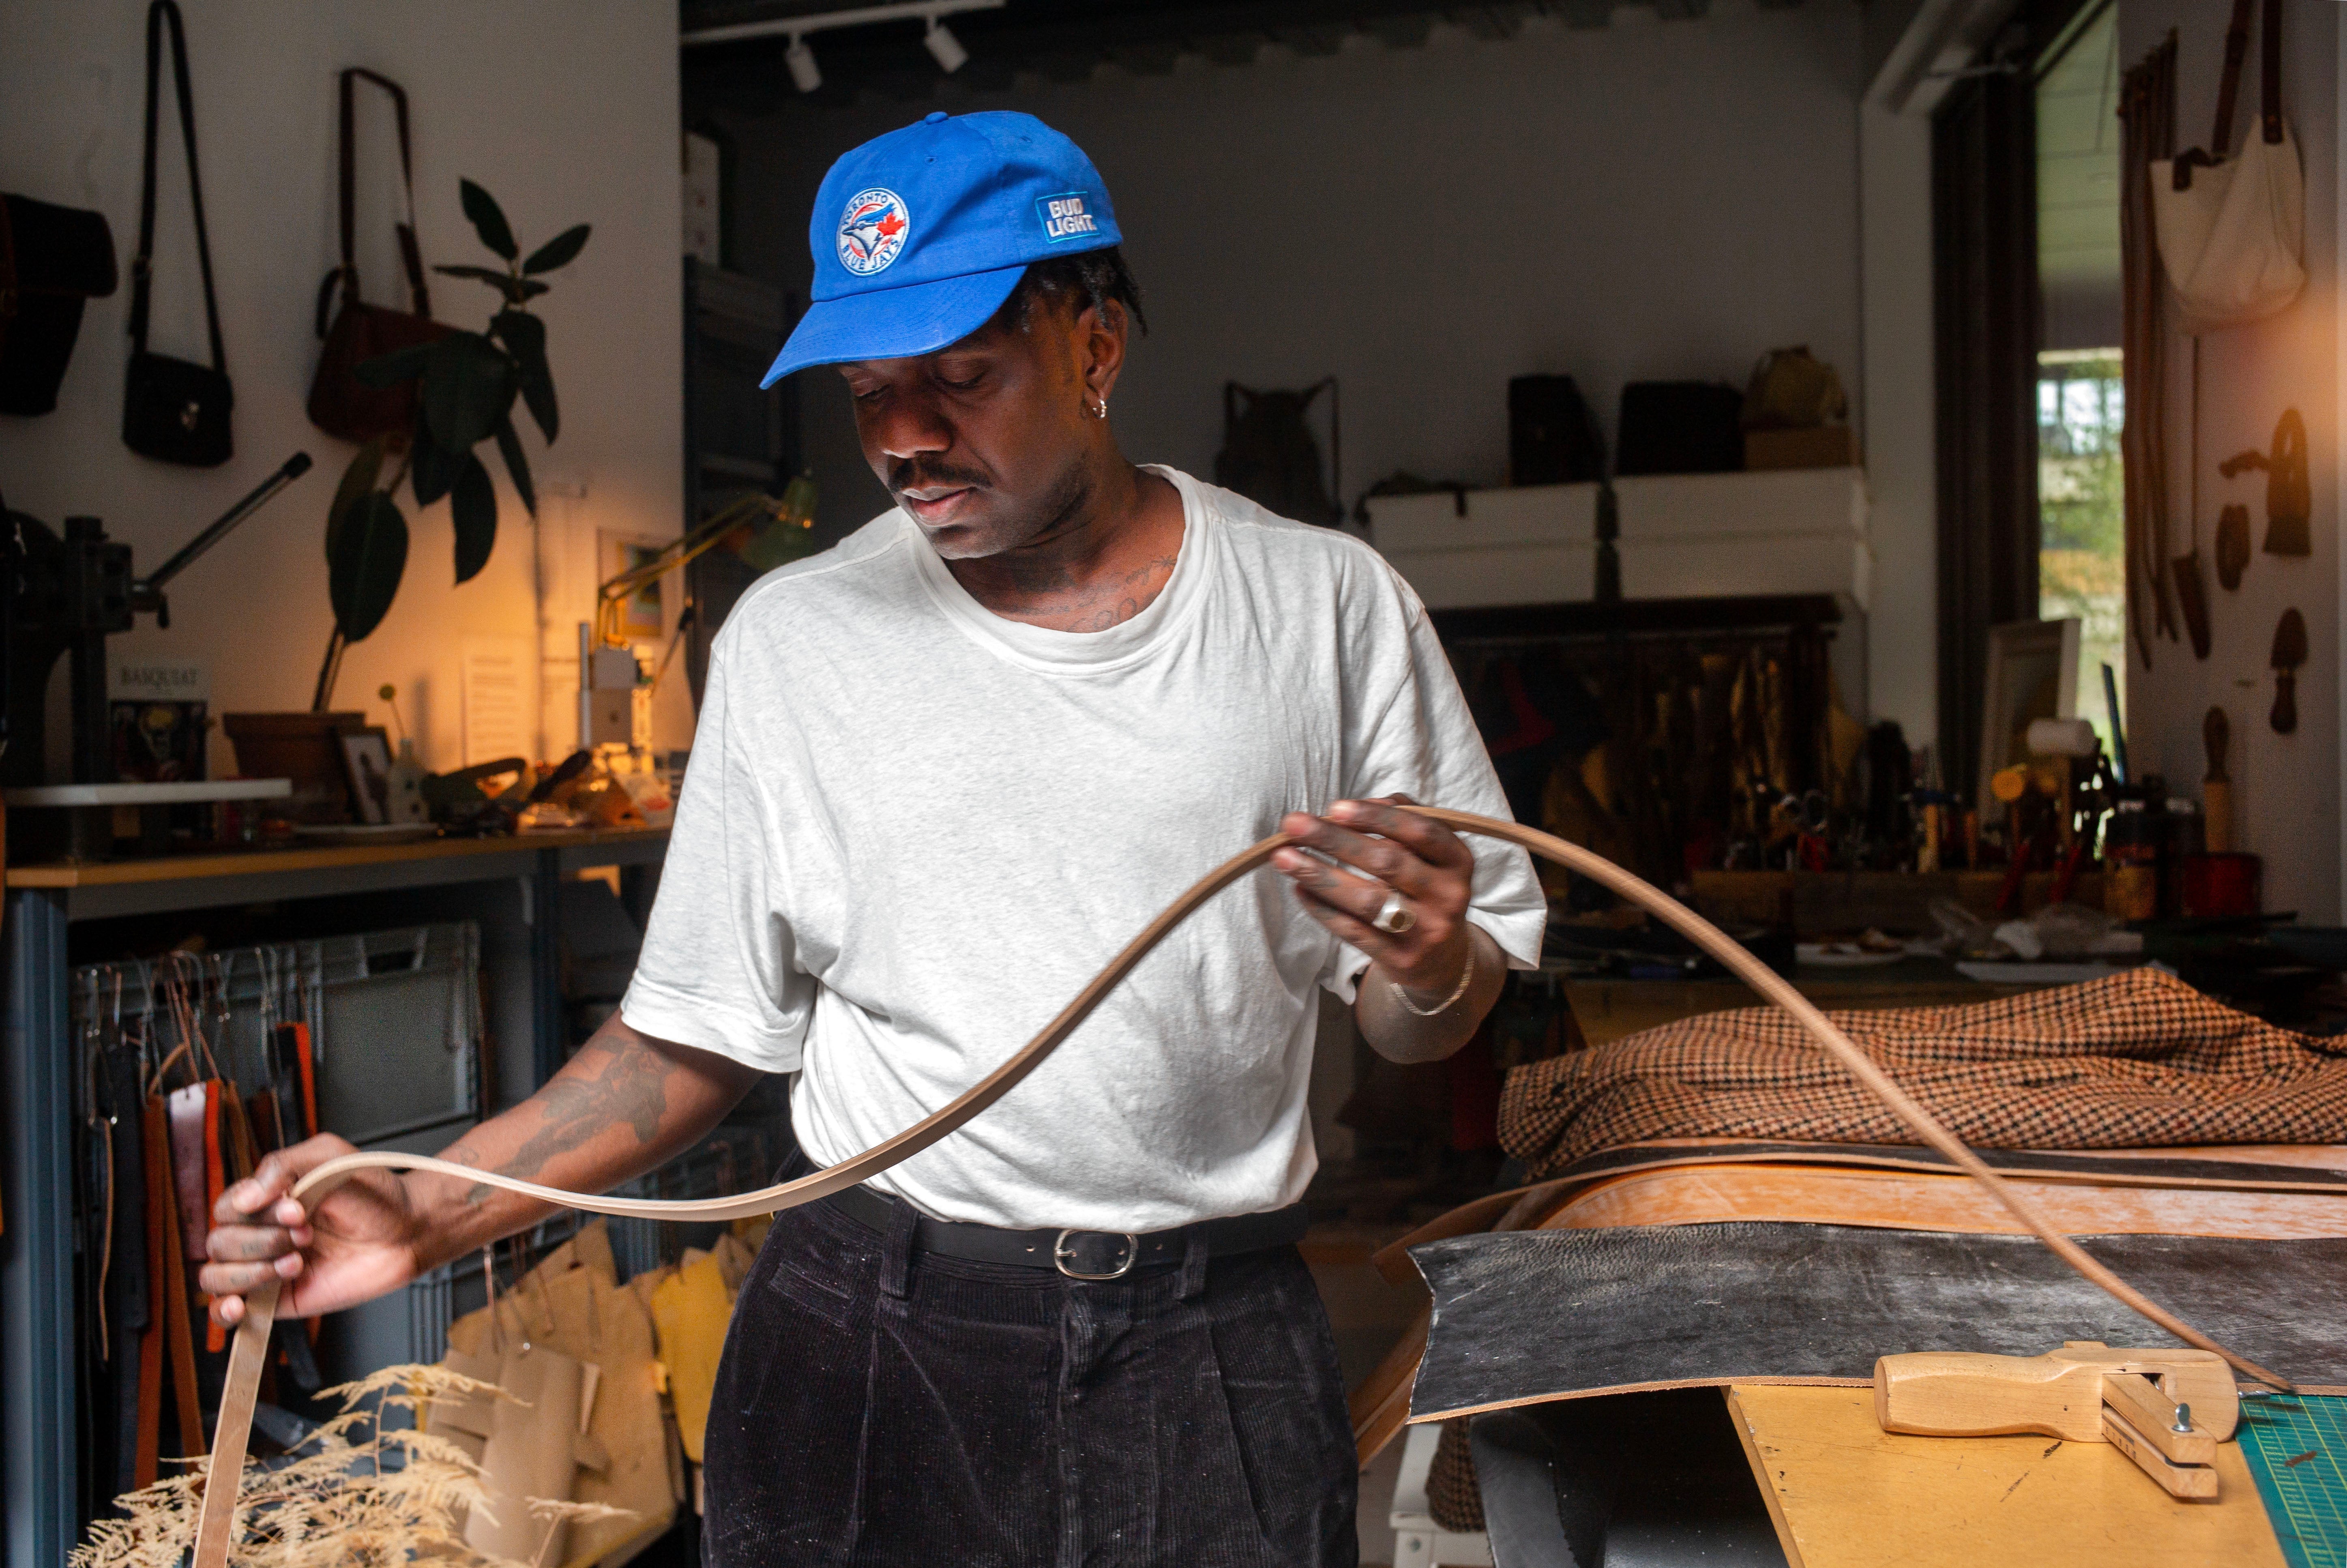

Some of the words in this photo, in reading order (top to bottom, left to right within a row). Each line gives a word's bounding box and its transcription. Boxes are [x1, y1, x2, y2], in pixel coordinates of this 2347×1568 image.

[844, 193, 888, 225] TORONTO
[1048, 198, 1083, 219] BUD
[841, 245, 865, 270] BLUE
[872, 240, 901, 268] JAYS
